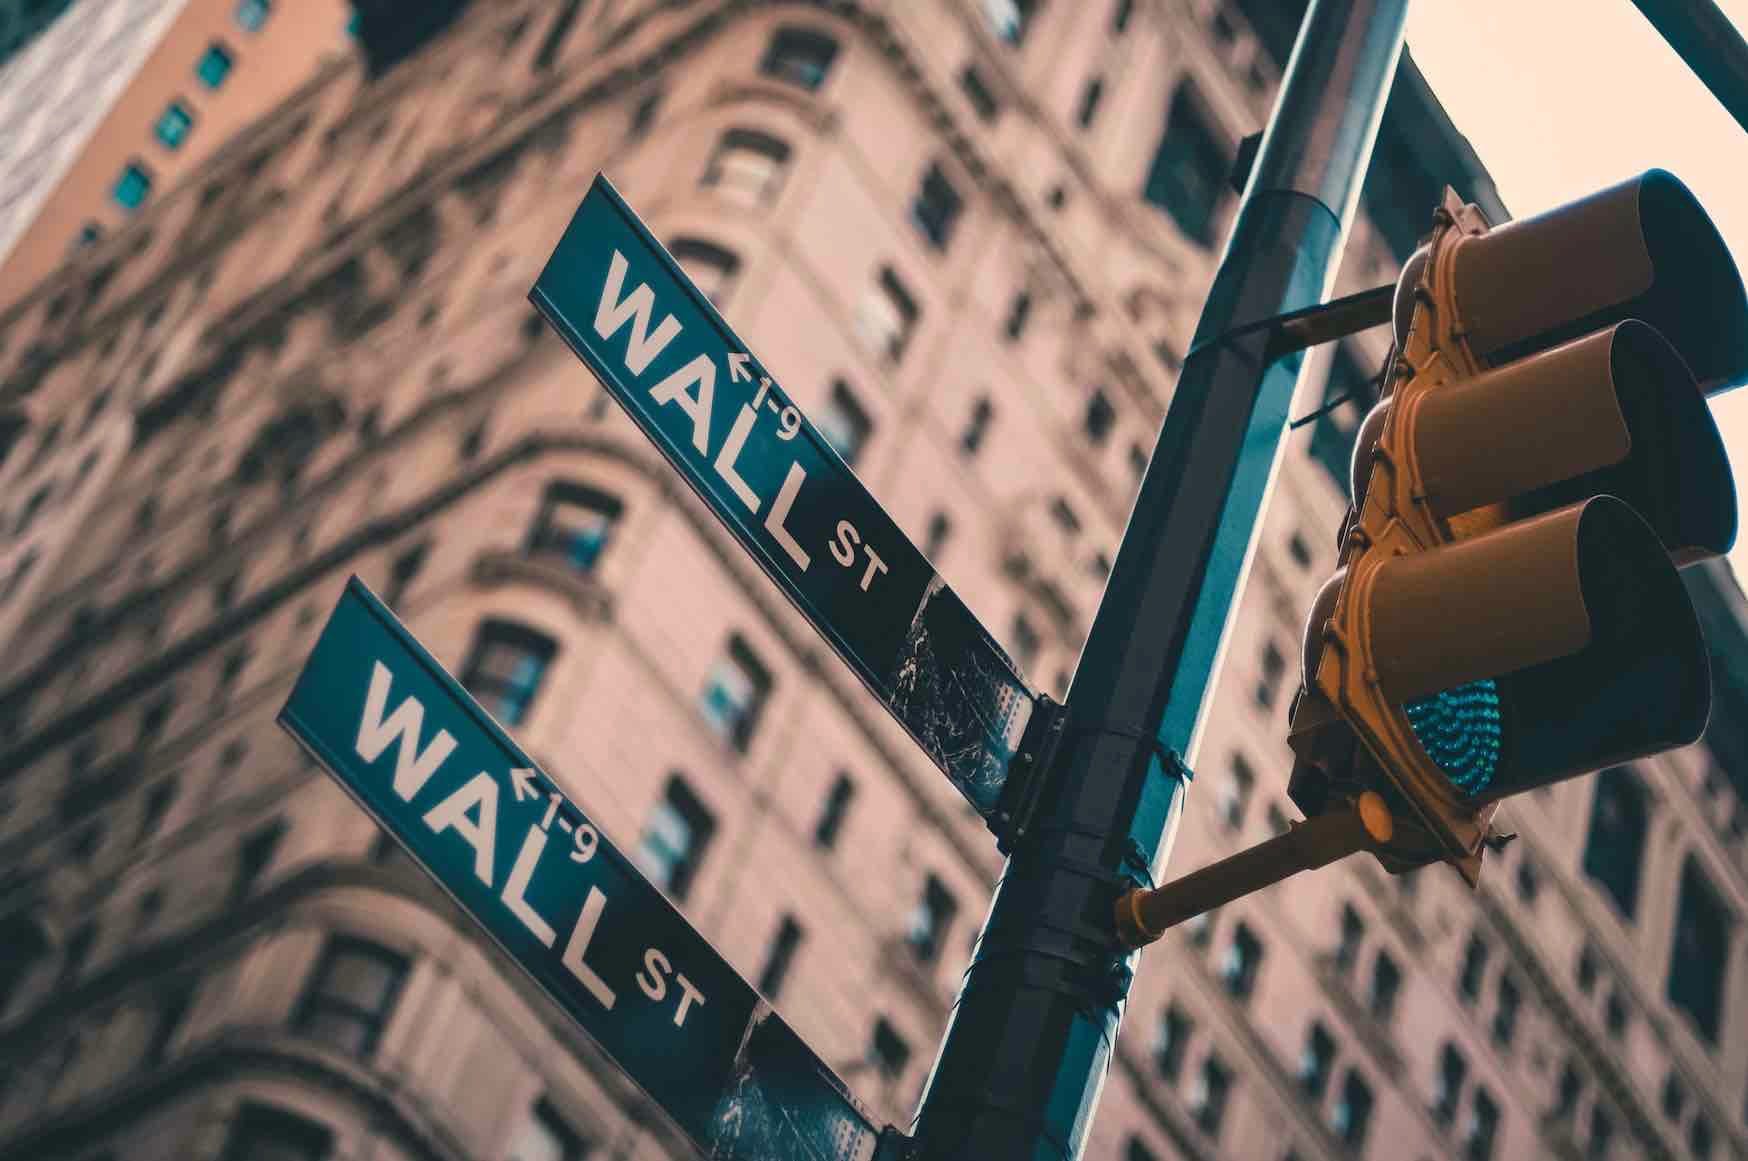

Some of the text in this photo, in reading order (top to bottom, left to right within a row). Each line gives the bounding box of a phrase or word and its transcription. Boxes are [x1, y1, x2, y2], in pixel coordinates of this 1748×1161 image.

[593, 249, 888, 592] WALL ST
[750, 377, 802, 441] 1-9
[355, 660, 705, 1027] WALL ST
[540, 794, 599, 863] 1-9
